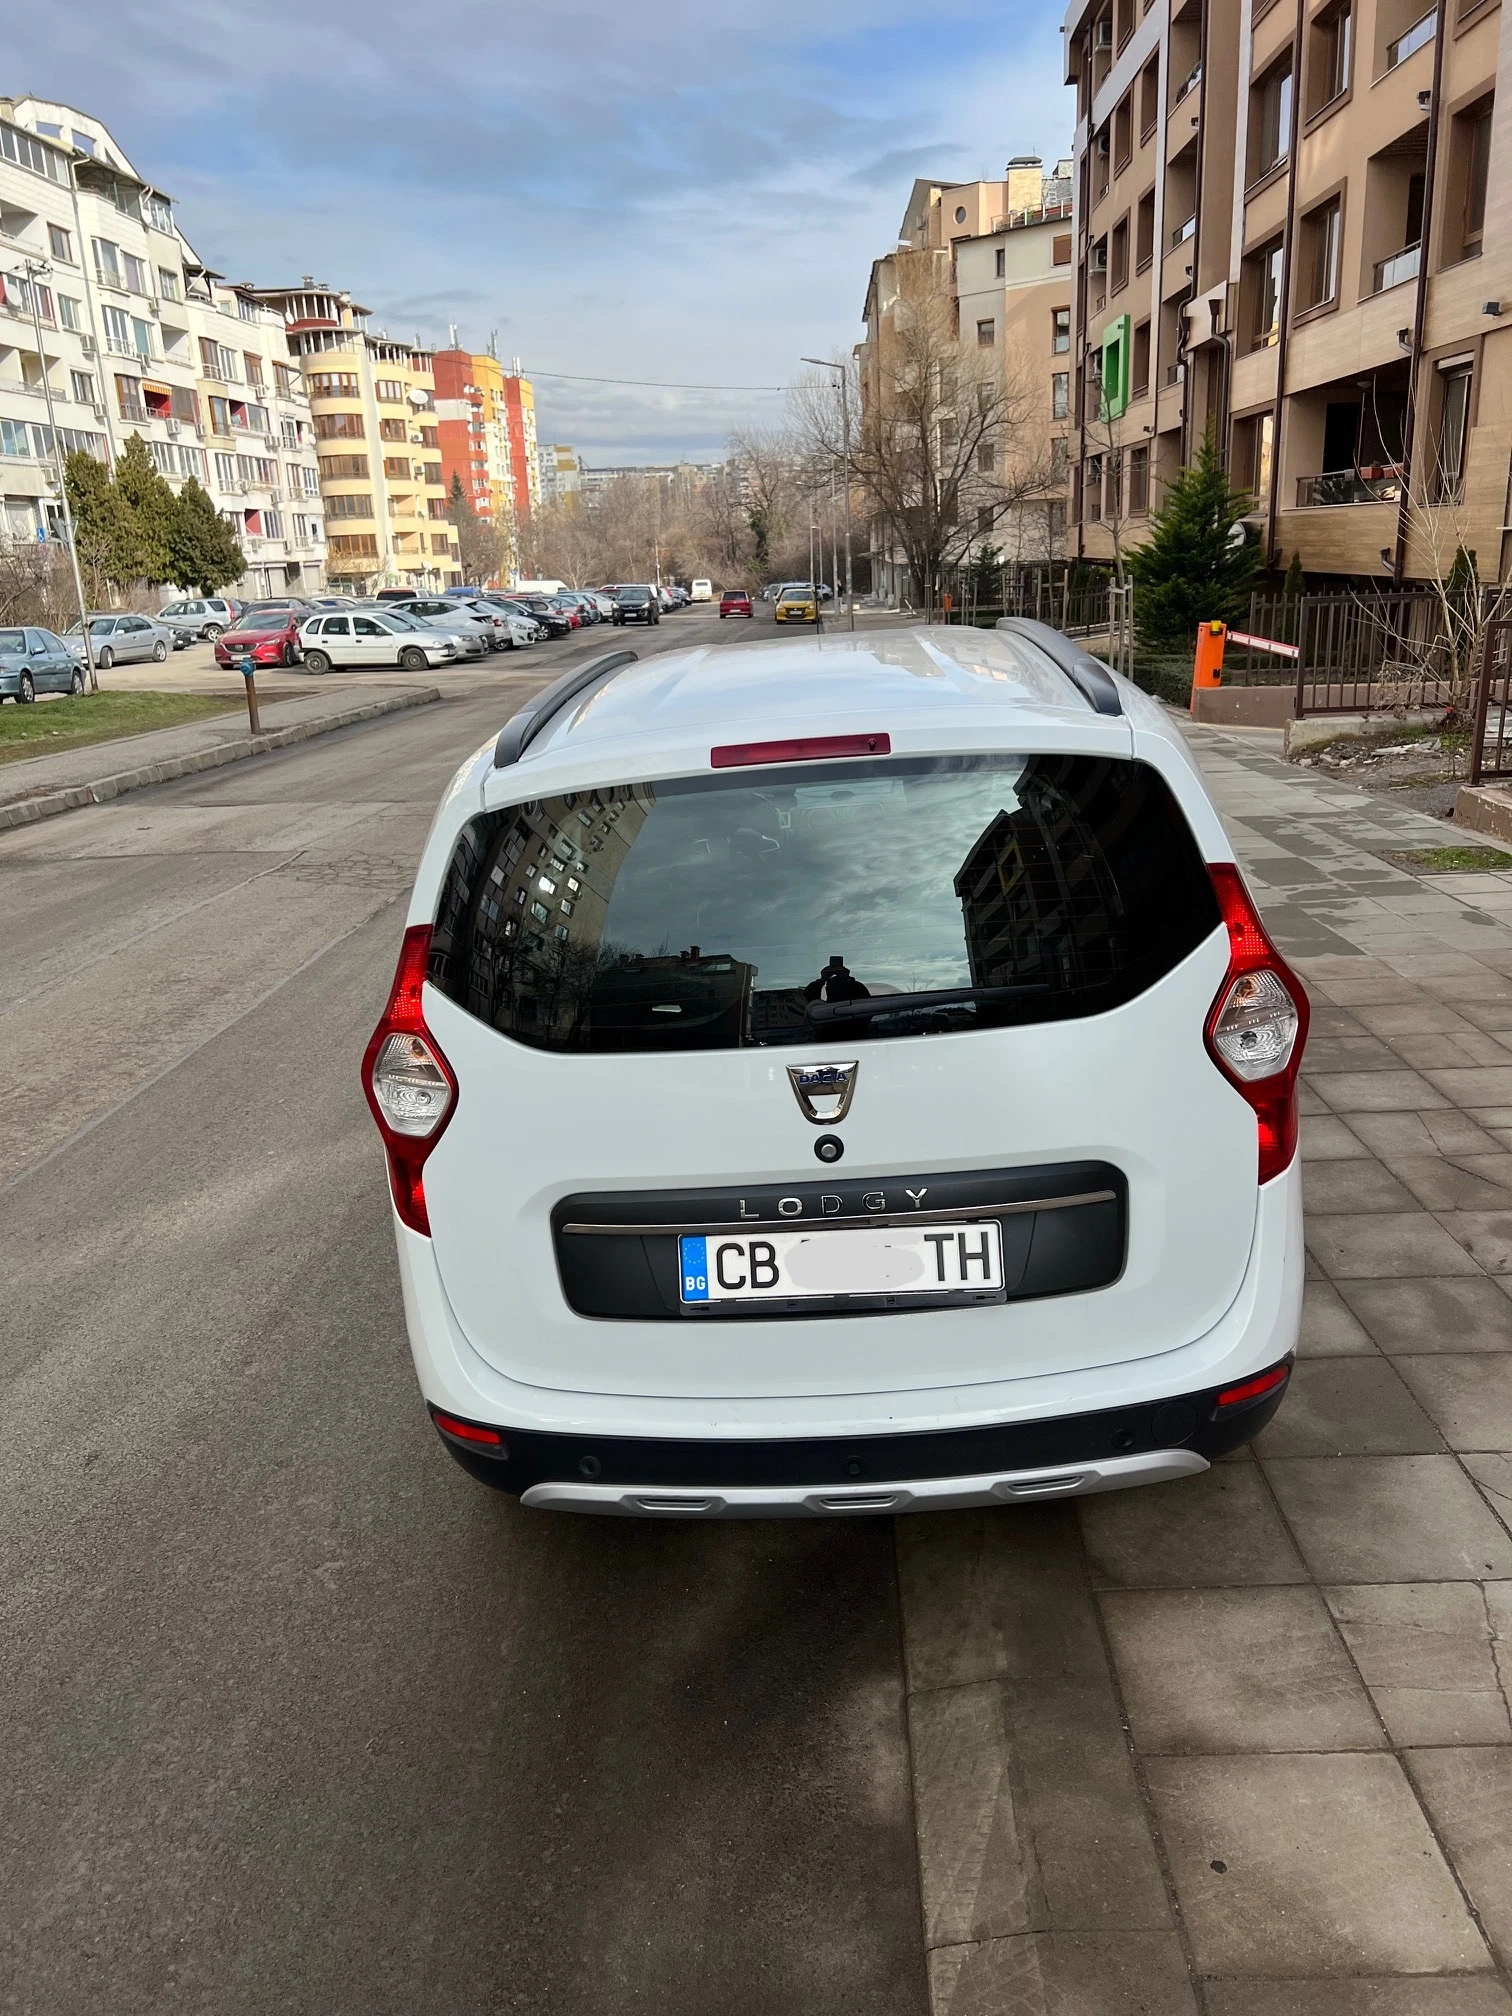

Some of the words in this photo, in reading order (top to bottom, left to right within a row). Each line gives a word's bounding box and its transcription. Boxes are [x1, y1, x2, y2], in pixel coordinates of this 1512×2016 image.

[799, 1072, 848, 1085] DACIA
[739, 1188, 928, 1219] LODGY
[716, 1241, 780, 1291] CB
[924, 1231, 991, 1282] TH
[685, 1275, 706, 1291] BG
